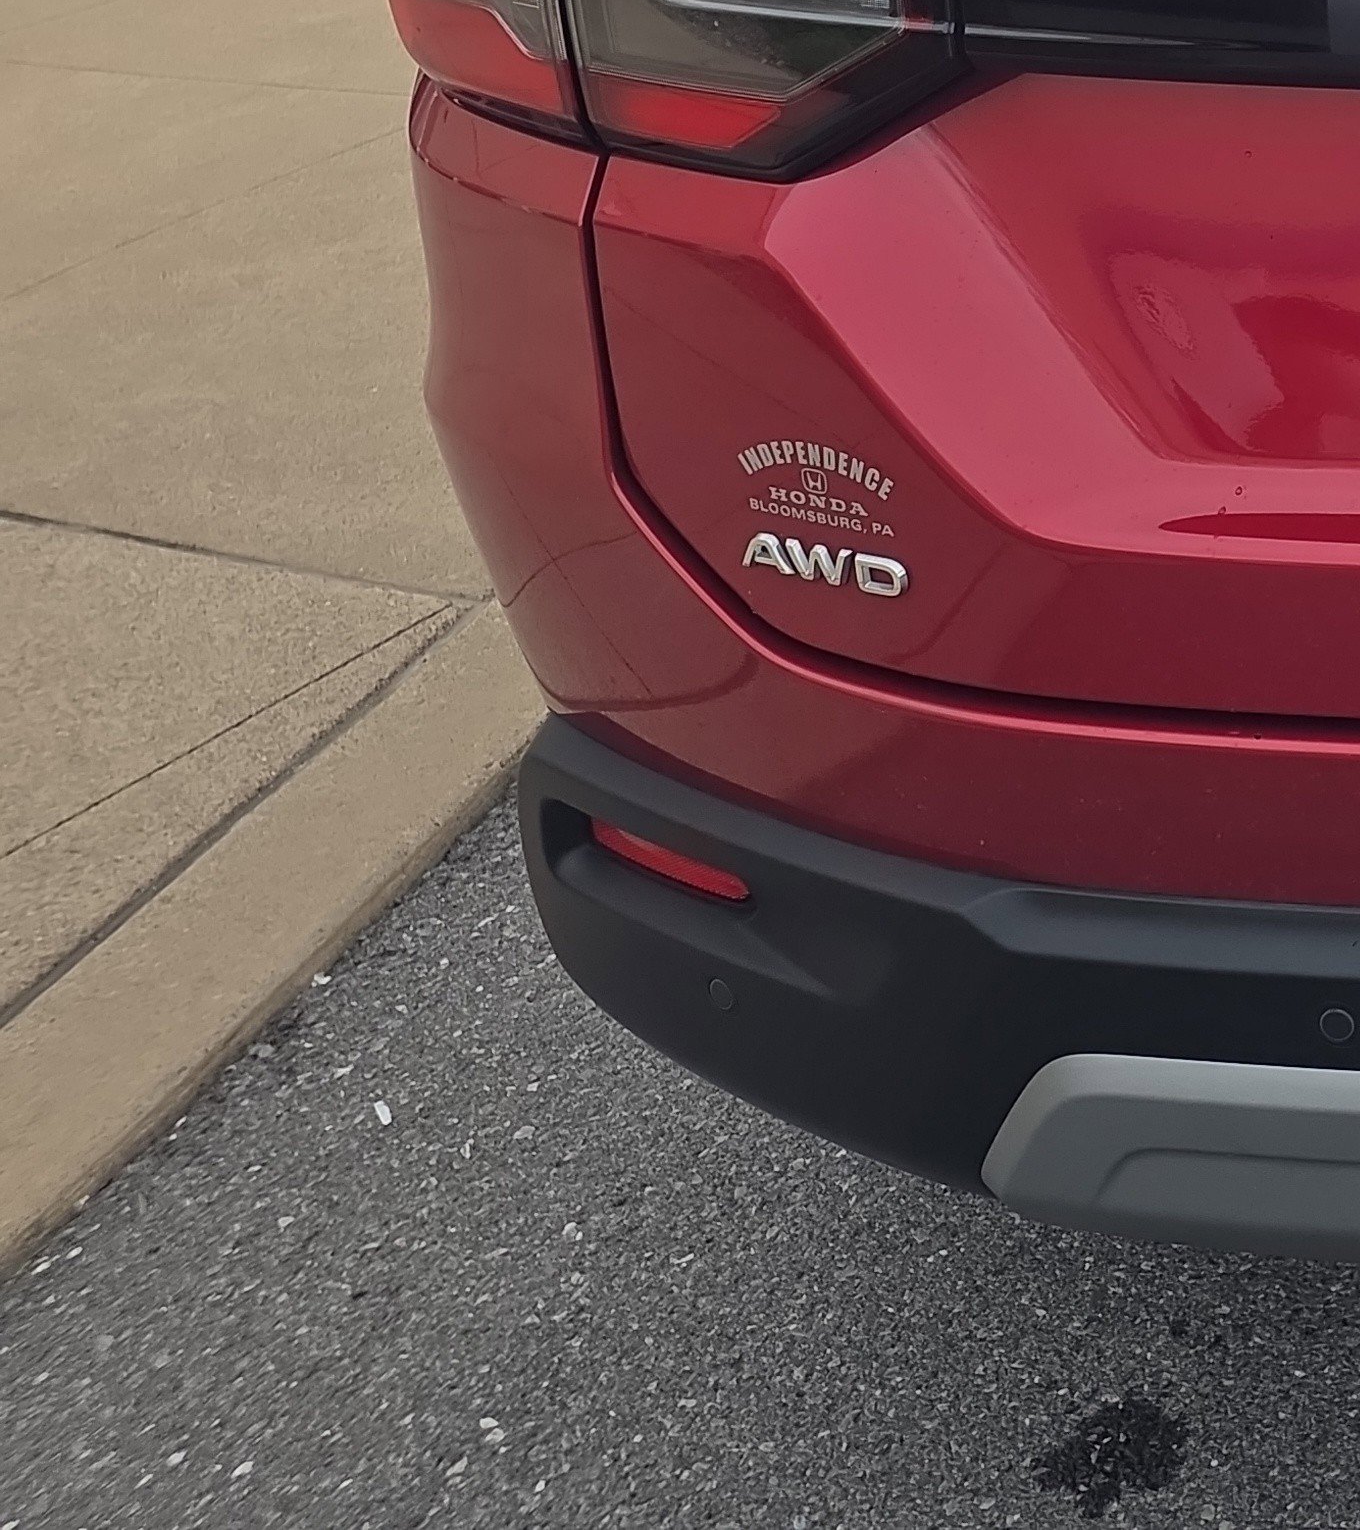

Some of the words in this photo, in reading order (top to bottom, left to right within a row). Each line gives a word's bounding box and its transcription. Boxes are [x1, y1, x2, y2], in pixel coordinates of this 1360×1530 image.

[737, 440, 894, 501] INDEPENDENCE
[749, 497, 868, 534] BLOOMSBURG,
[872, 522, 895, 537] PA
[768, 486, 869, 517] HONDA
[741, 532, 909, 597] AWD
